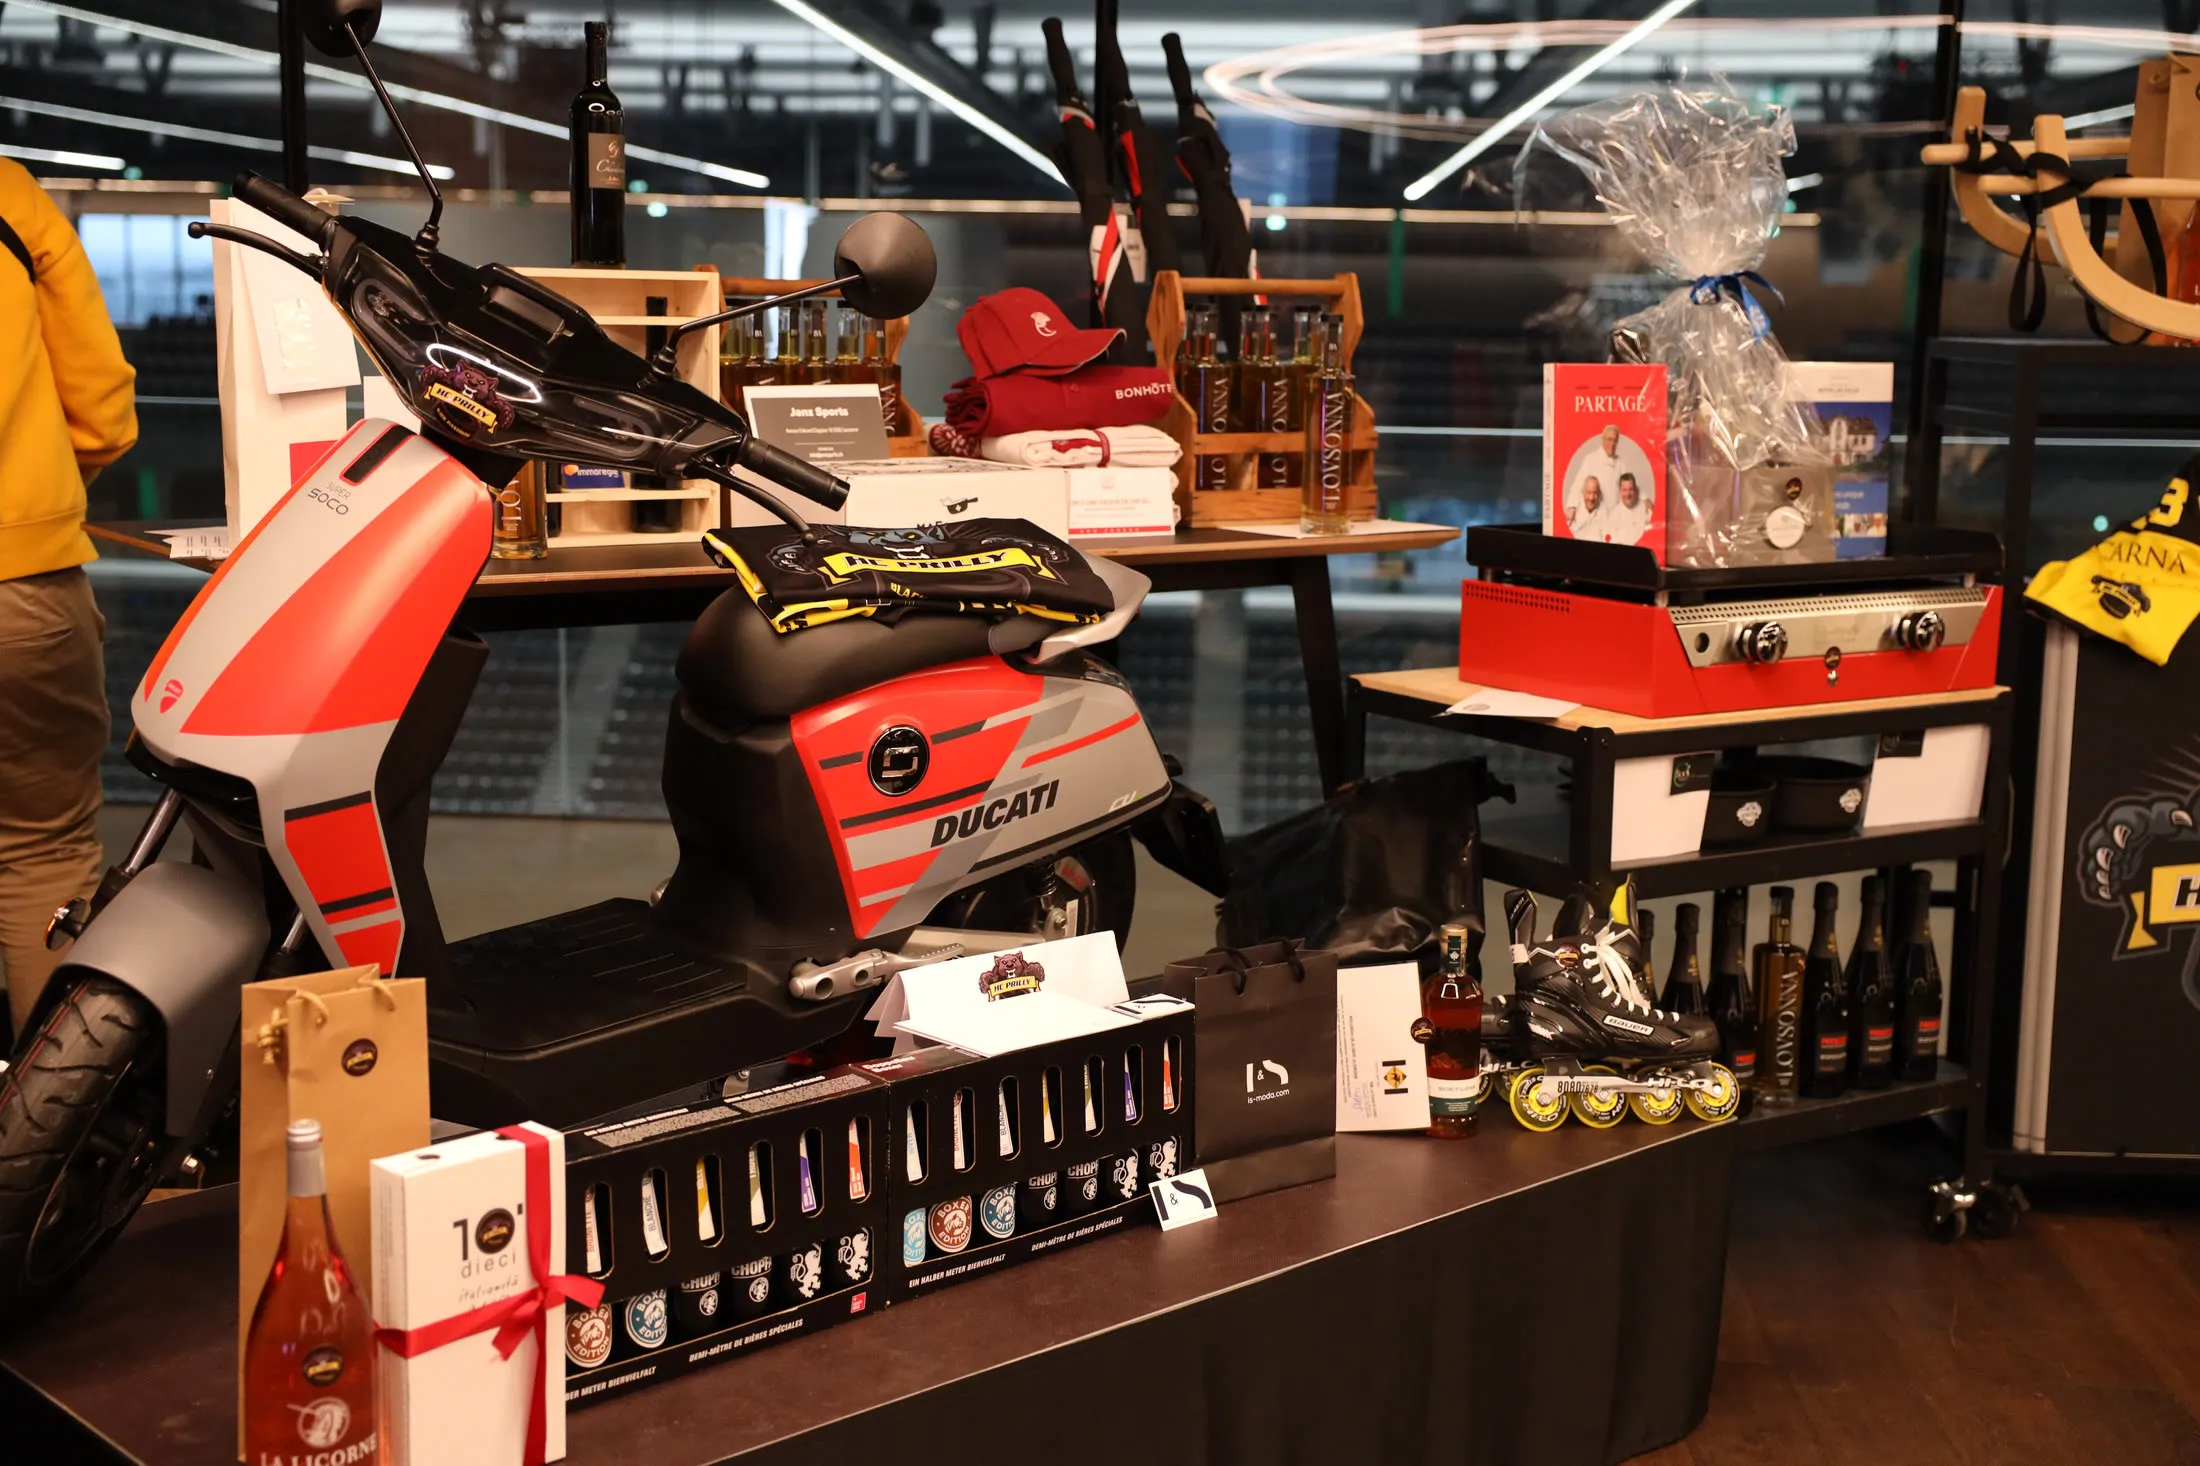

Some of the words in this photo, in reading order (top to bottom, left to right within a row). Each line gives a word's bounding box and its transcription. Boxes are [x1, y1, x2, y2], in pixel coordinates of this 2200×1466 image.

[452, 395, 490, 418] PRILLY
[815, 407, 849, 418] Sports
[1575, 395, 1647, 412] PARTAGE
[326, 481, 351, 500] SUPER
[307, 488, 349, 515] SOCO
[896, 551, 1007, 569] PRILLY
[930, 779, 1060, 848] DUCATI
[1006, 978, 1031, 988] PRILLY
[1608, 1018, 1649, 1033] BAUER
[1247, 1088, 1290, 1104] is-moda.com
[937, 1201, 969, 1218] BOXER
[938, 1225, 970, 1244] EDITION
[1067, 1232, 1075, 1240] DE
[461, 1249, 516, 1278] dieci
[908, 1278, 920, 1288] EIN
[920, 1271, 945, 1285] HALBER
[945, 1265, 967, 1278] METER
[966, 1253, 1007, 1271] BIERVIELFALT
[572, 1308, 609, 1329] BOXER
[573, 1336, 609, 1358] EDITION
[733, 1338, 744, 1349] DE
[581, 1382, 607, 1397] METER
[608, 1366, 657, 1388] BIERVIELFALT
